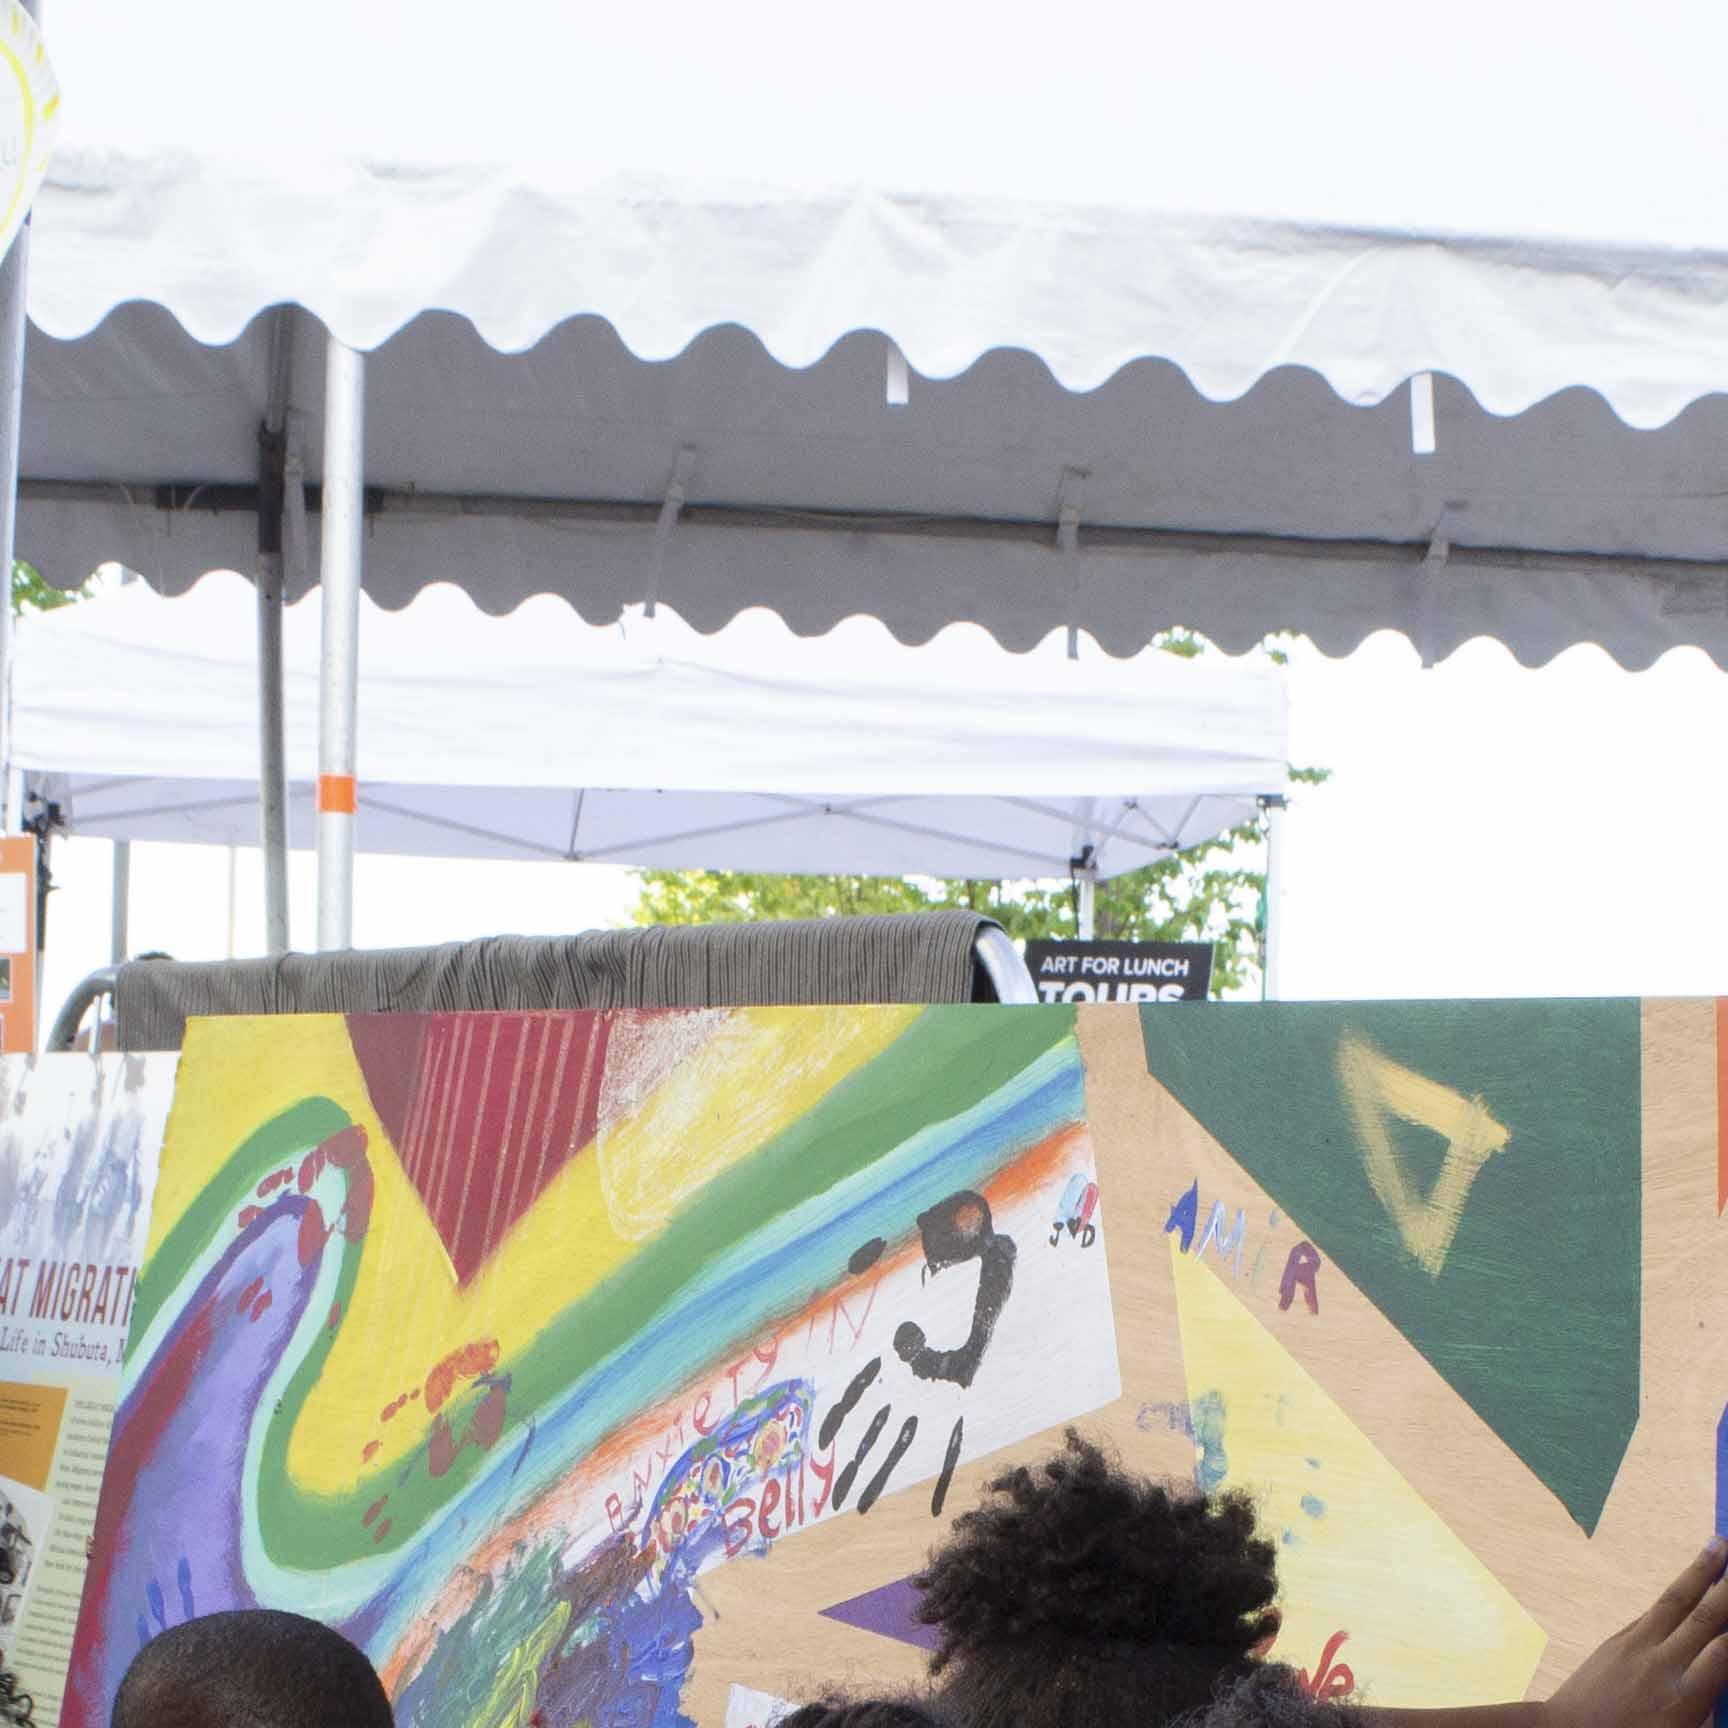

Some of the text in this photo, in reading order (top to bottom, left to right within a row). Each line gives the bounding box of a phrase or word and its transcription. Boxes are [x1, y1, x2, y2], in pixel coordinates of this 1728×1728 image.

[1041, 956, 1190, 977] ART FOR LUNCH
[31, 1332, 48, 1357] in
